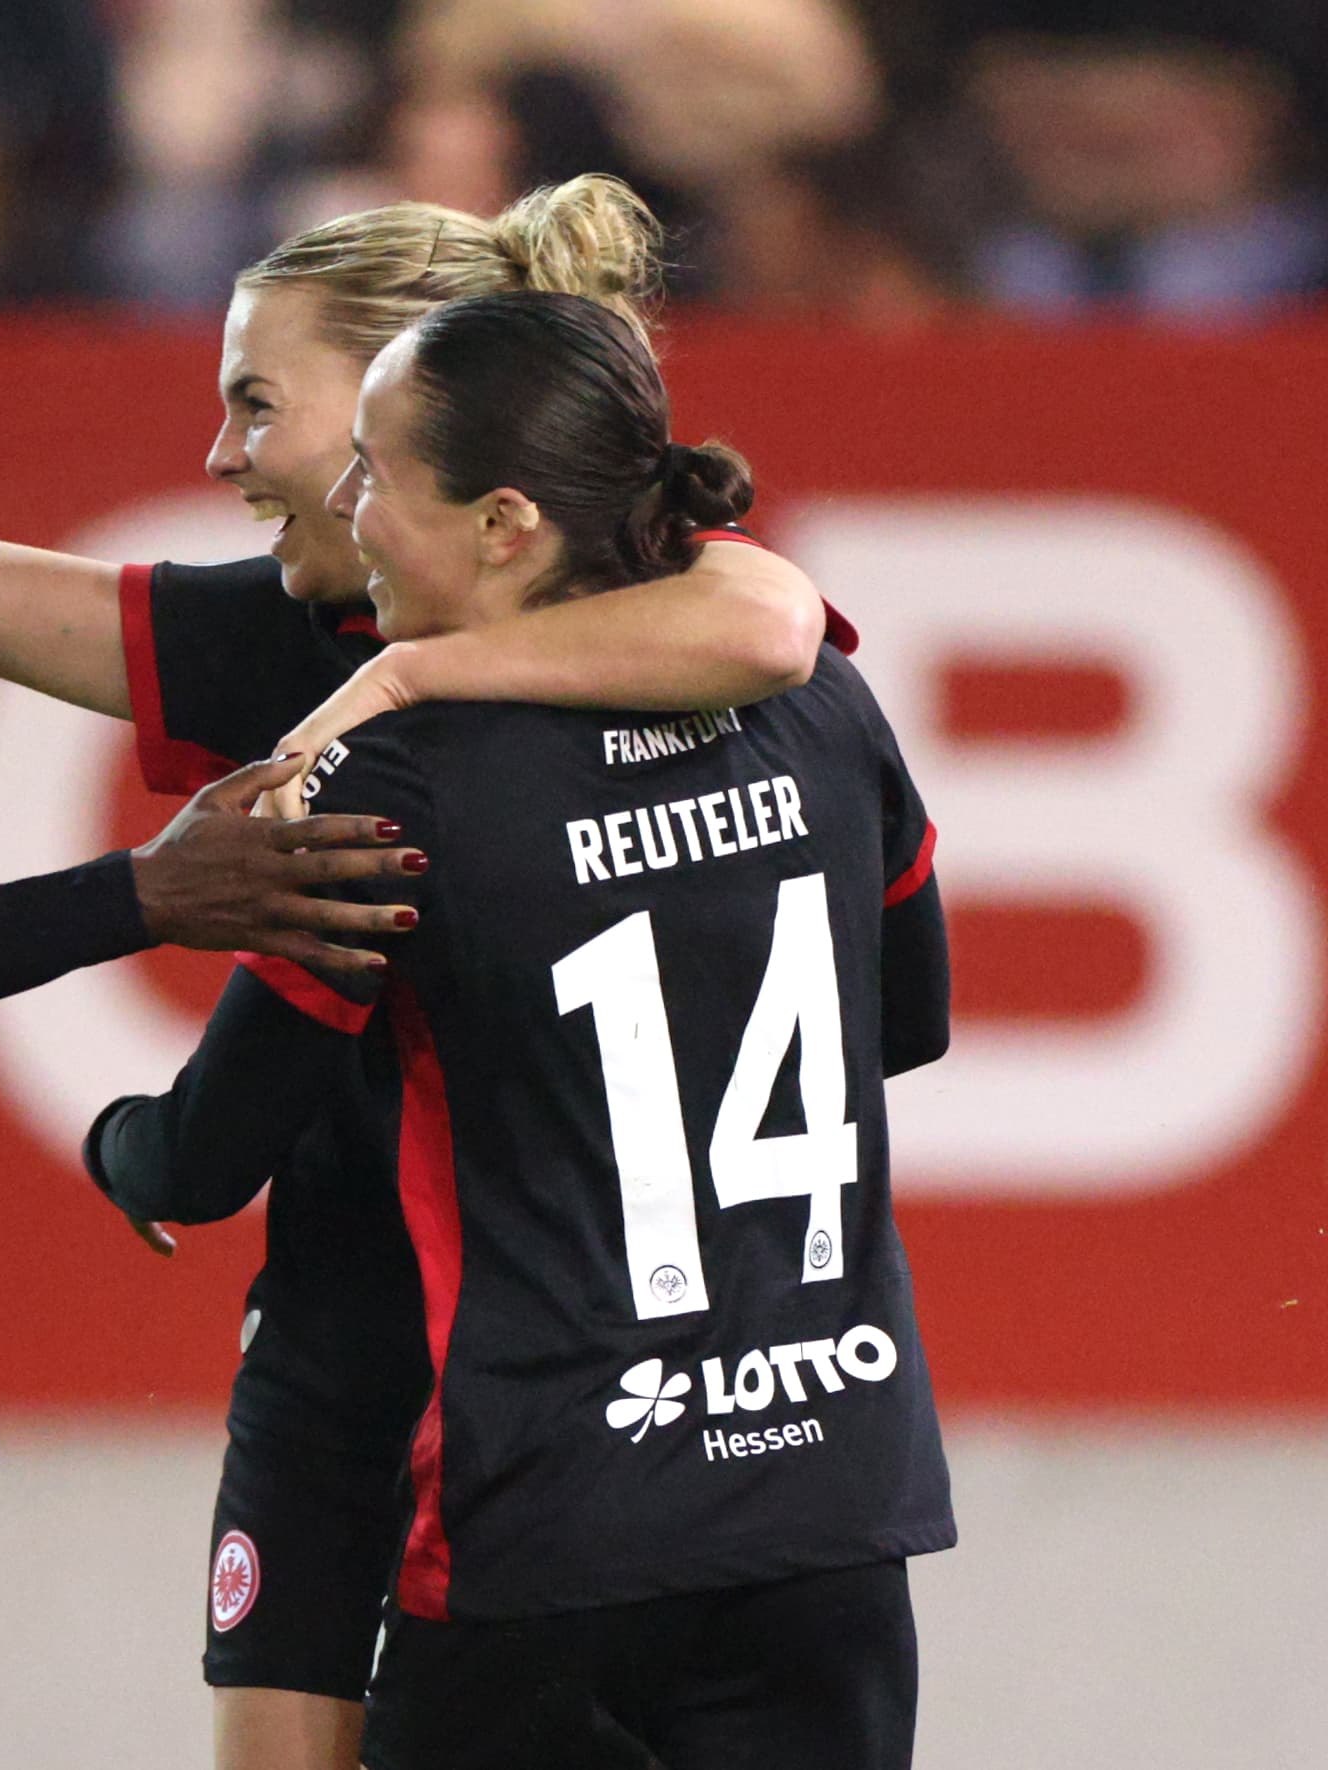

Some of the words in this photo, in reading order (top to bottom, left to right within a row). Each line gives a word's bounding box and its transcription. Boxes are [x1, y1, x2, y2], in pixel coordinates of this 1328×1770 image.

[566, 774, 808, 885] REUTELER
[552, 872, 858, 1321] 14
[701, 1324, 898, 1415] LOTTO
[703, 1418, 824, 1462] Hessen
